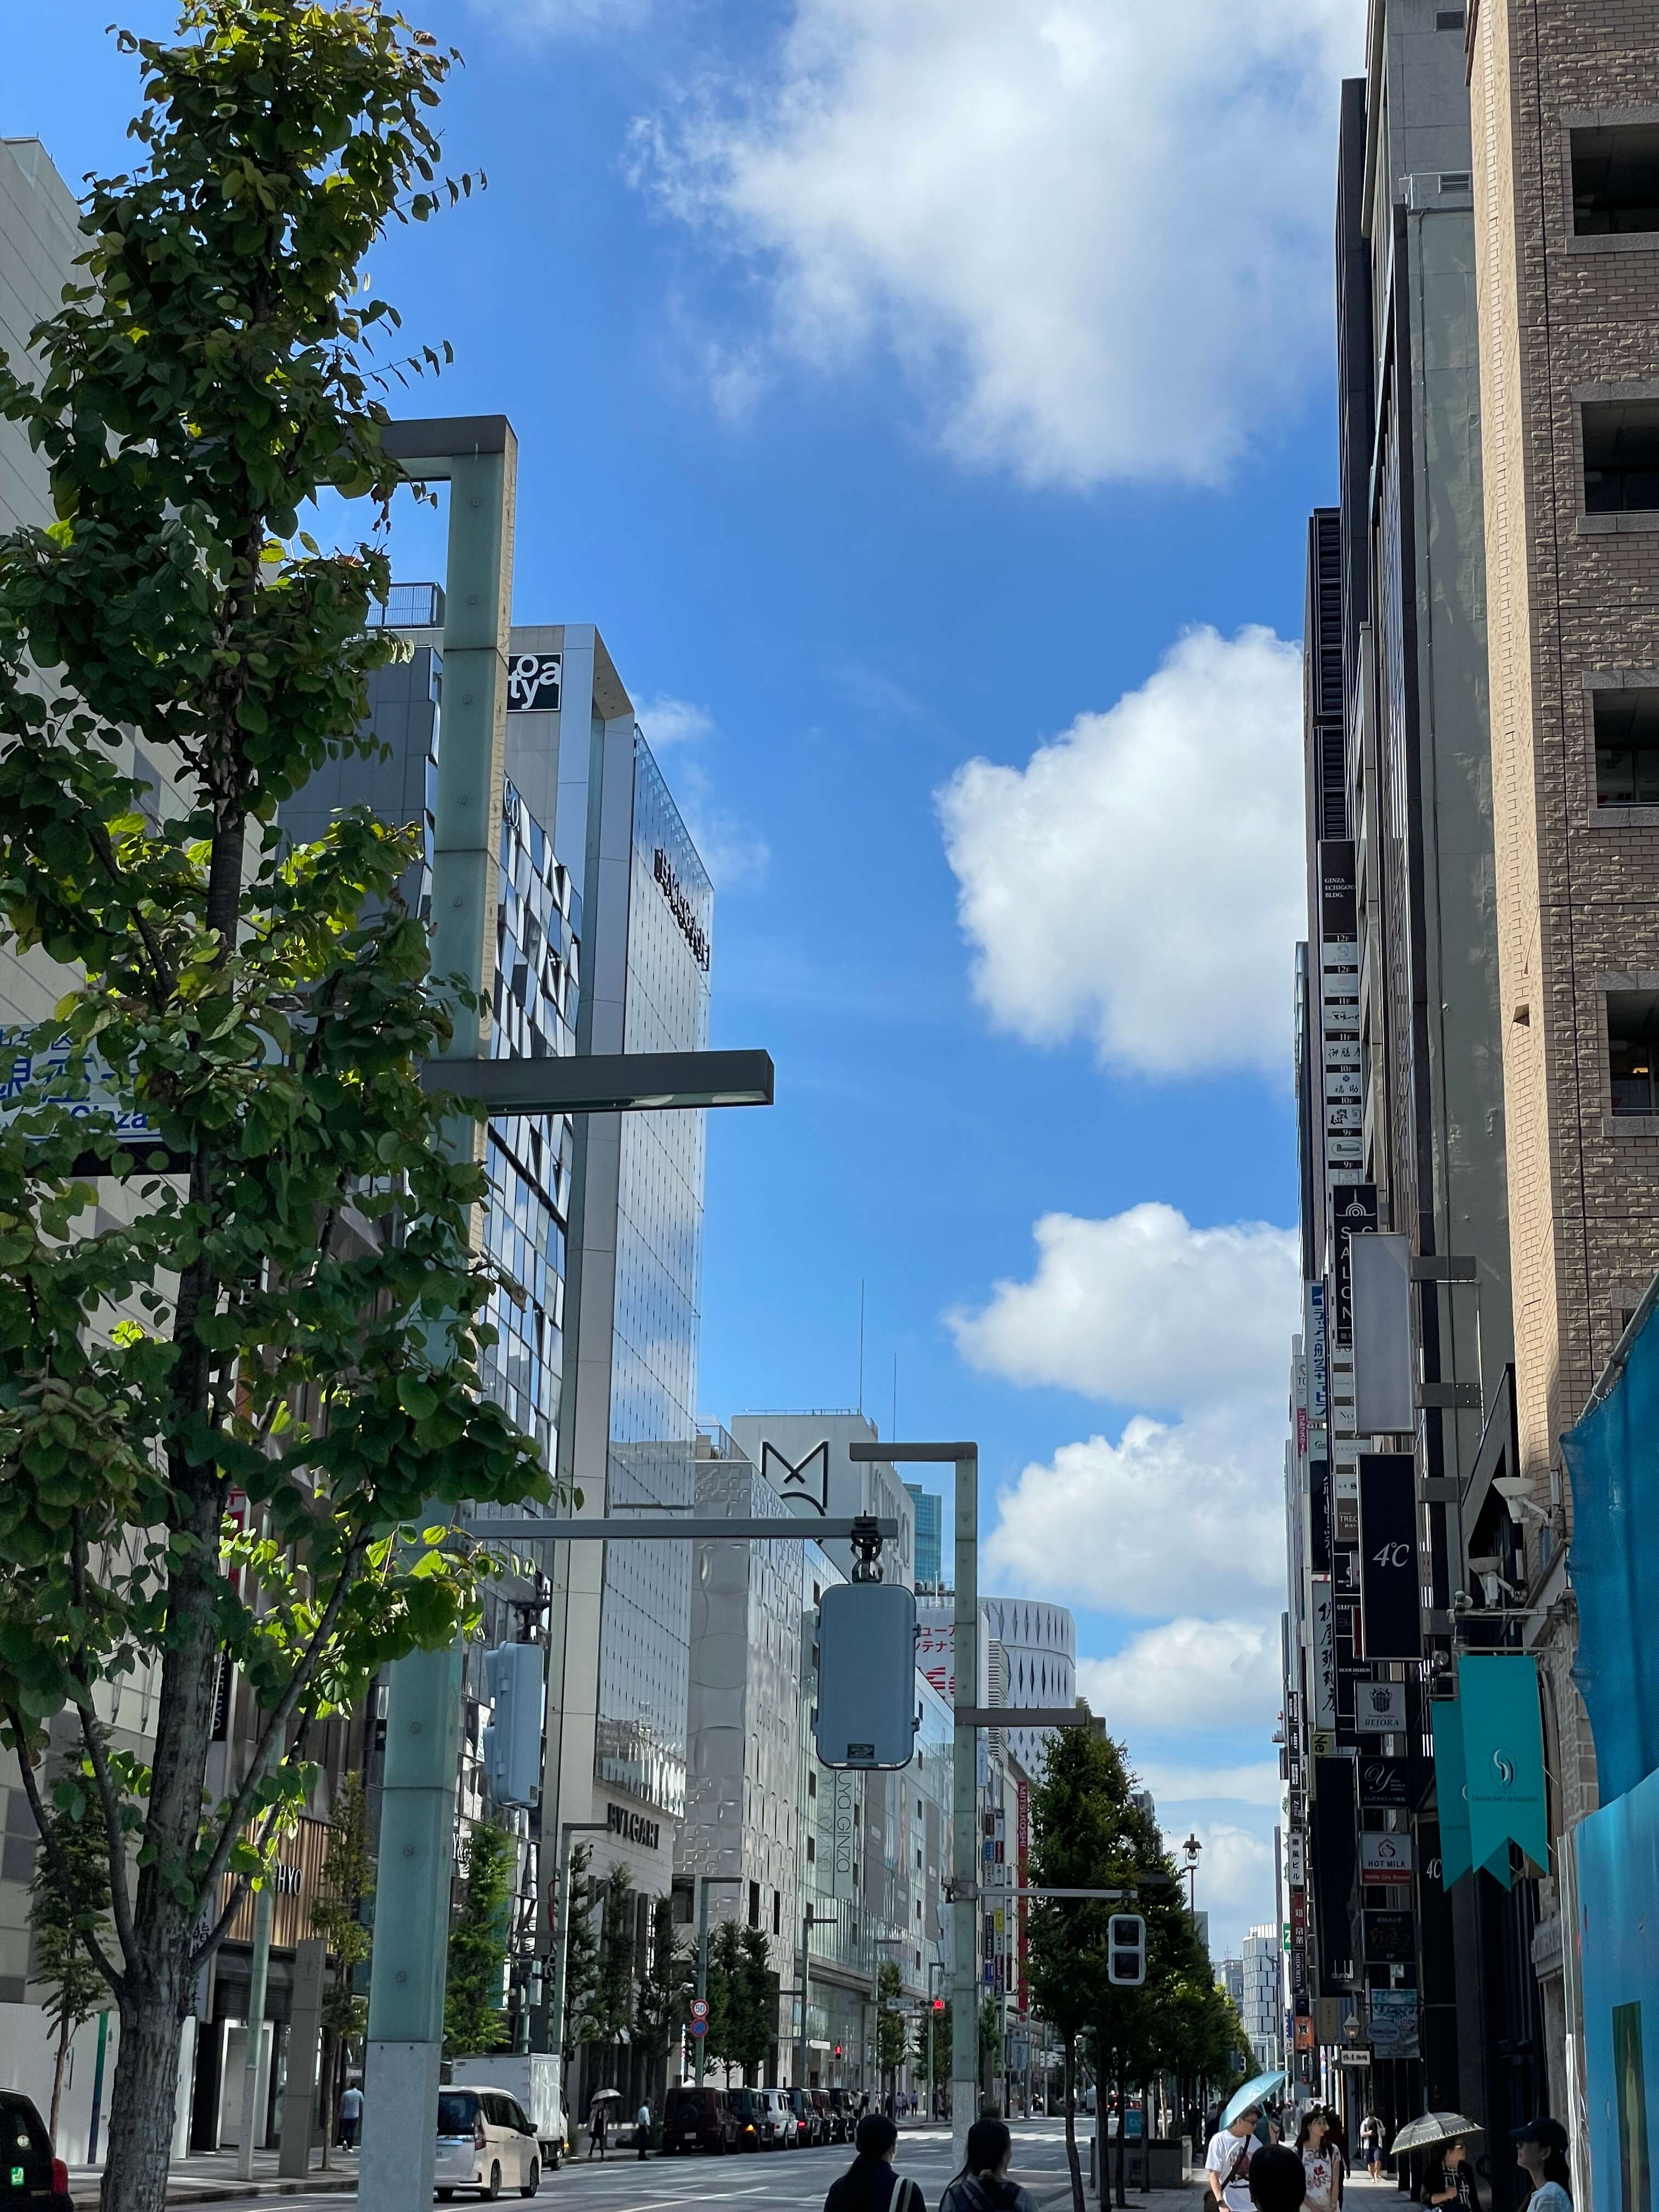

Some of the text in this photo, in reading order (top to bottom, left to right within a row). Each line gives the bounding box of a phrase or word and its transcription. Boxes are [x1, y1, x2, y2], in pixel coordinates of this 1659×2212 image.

[1365, 1719, 1400, 1727] BEJORA
[607, 1803, 660, 1850] BVLGARI
[695, 2004, 706, 2013] 50
